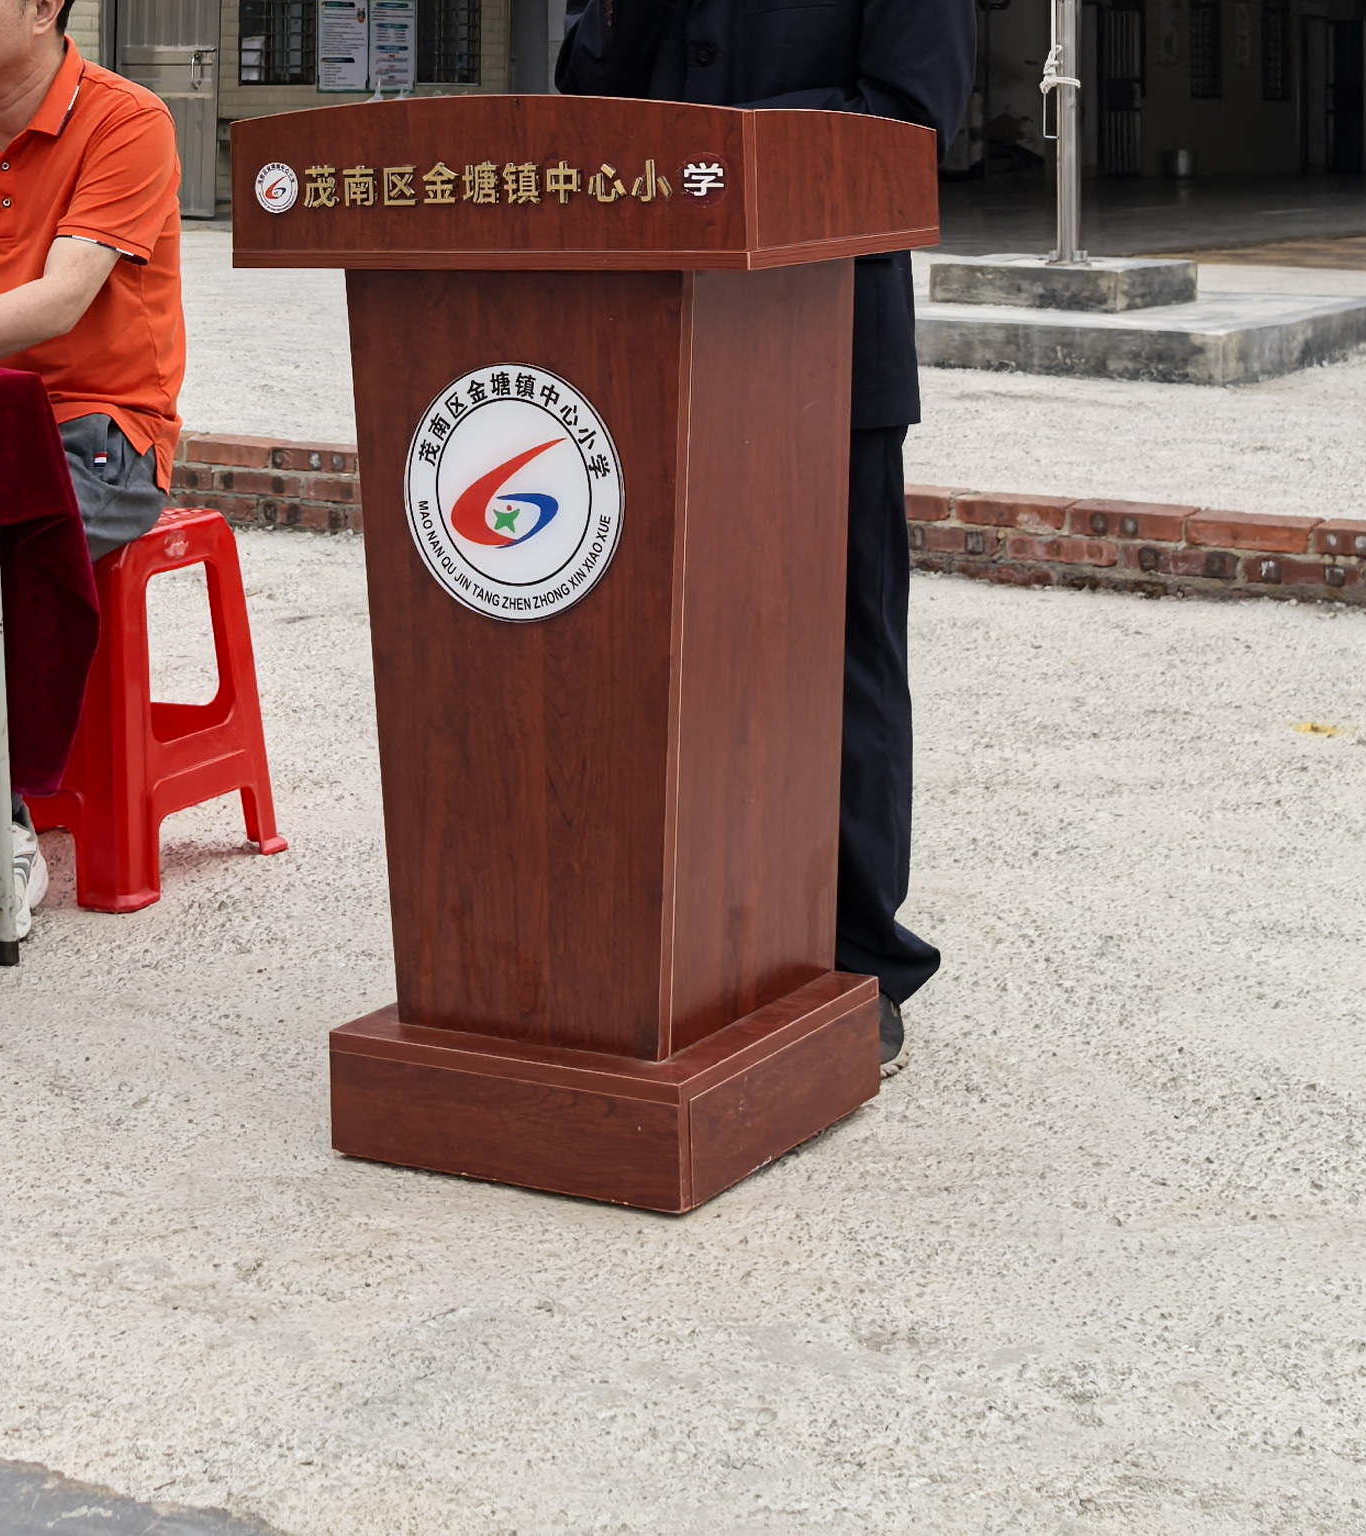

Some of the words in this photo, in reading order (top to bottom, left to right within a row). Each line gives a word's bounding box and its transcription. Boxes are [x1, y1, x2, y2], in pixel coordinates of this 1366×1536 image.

[303, 158, 725, 209] 茂南区金塘镇中心小学
[418, 371, 611, 480] 茂南区金塘镇中心小学
[418, 500, 433, 530] MAO
[426, 530, 446, 558] NAN
[441, 556, 457, 575] QU
[454, 572, 472, 591] JIN
[472, 583, 500, 607] TANG
[501, 596, 531, 611] ZHEN
[532, 583, 571, 610] ZHONG
[567, 567, 587, 590] XIN
[581, 542, 603, 573] XIAO
[596, 514, 611, 543] XUE
